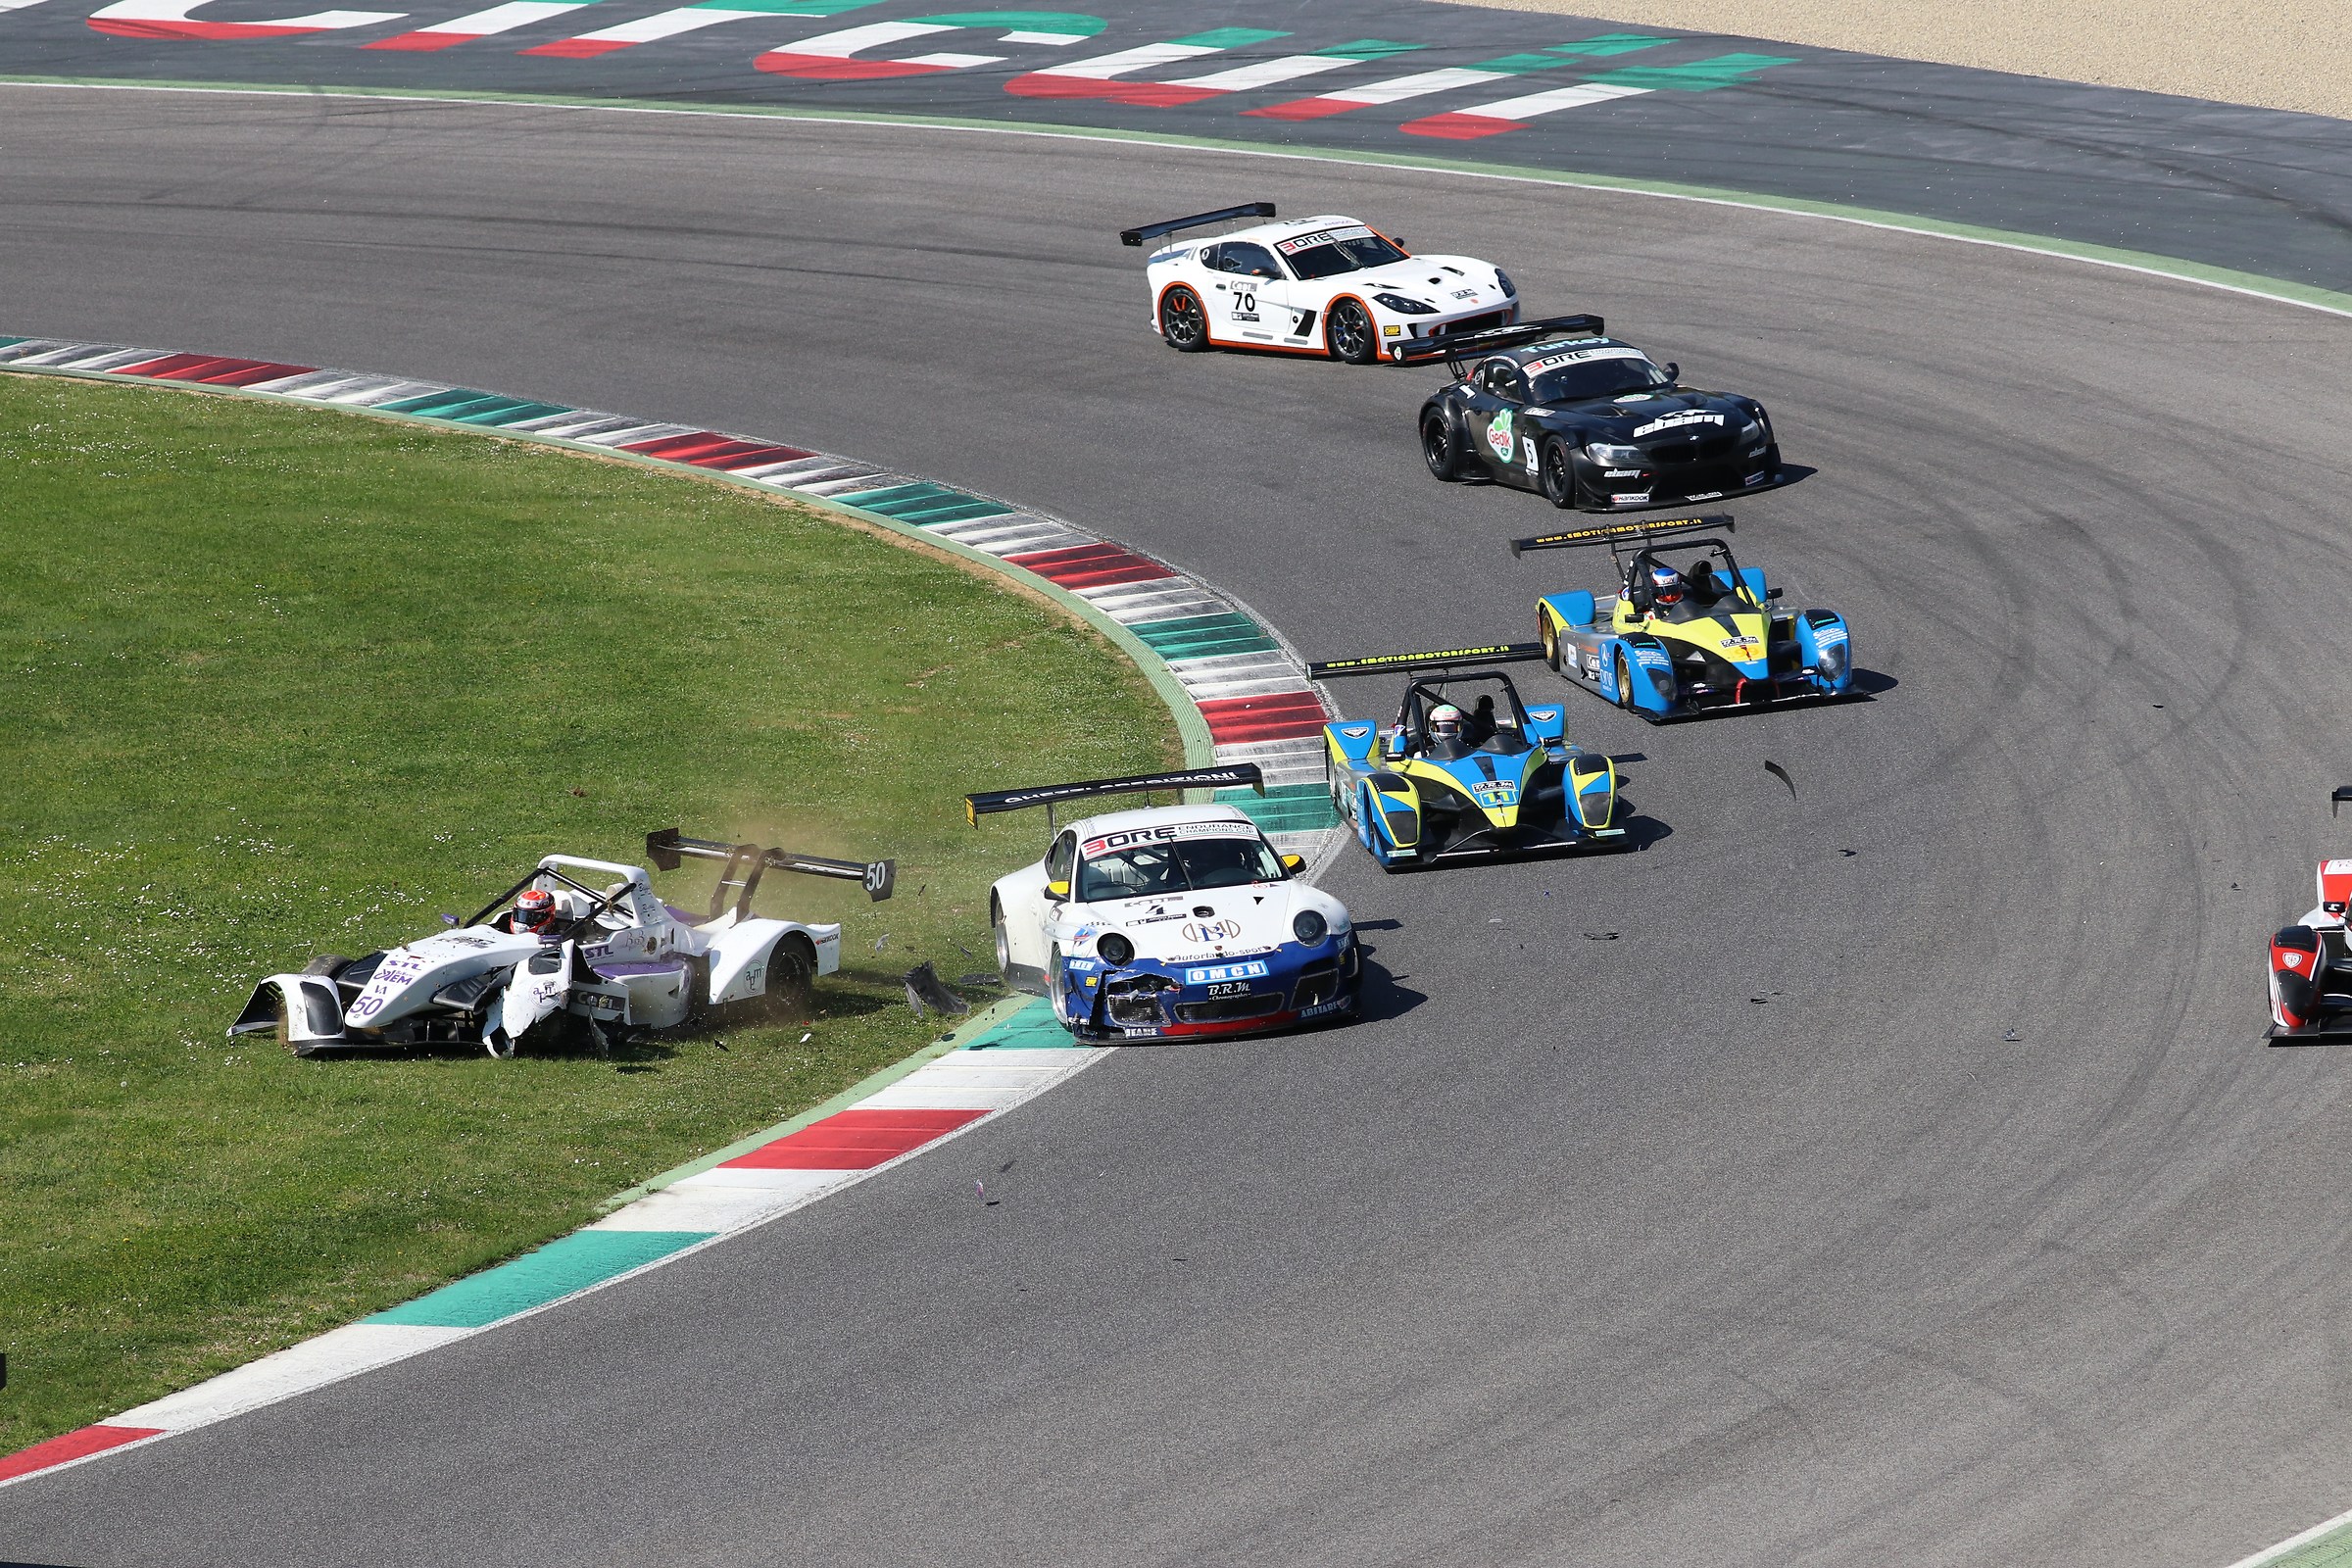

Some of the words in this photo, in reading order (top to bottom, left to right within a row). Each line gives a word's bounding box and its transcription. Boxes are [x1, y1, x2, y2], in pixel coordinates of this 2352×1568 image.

[1234, 292, 1255, 312] 70
[1520, 337, 1609, 353] Turkey
[1525, 351, 1592, 373] 3ORE
[1527, 442, 1534, 464] 5
[1484, 792, 1510, 804] 11
[1084, 827, 1178, 856] 3ORE
[1178, 822, 1255, 833] ENDURANCE
[866, 861, 886, 891] 50
[1145, 904, 1166, 915] 4
[584, 946, 614, 959] STL
[1173, 945, 1271, 961] Autorlado-spor
[386, 960, 422, 971] STL
[1192, 963, 1261, 981] OMCN
[350, 997, 383, 1016] 50
